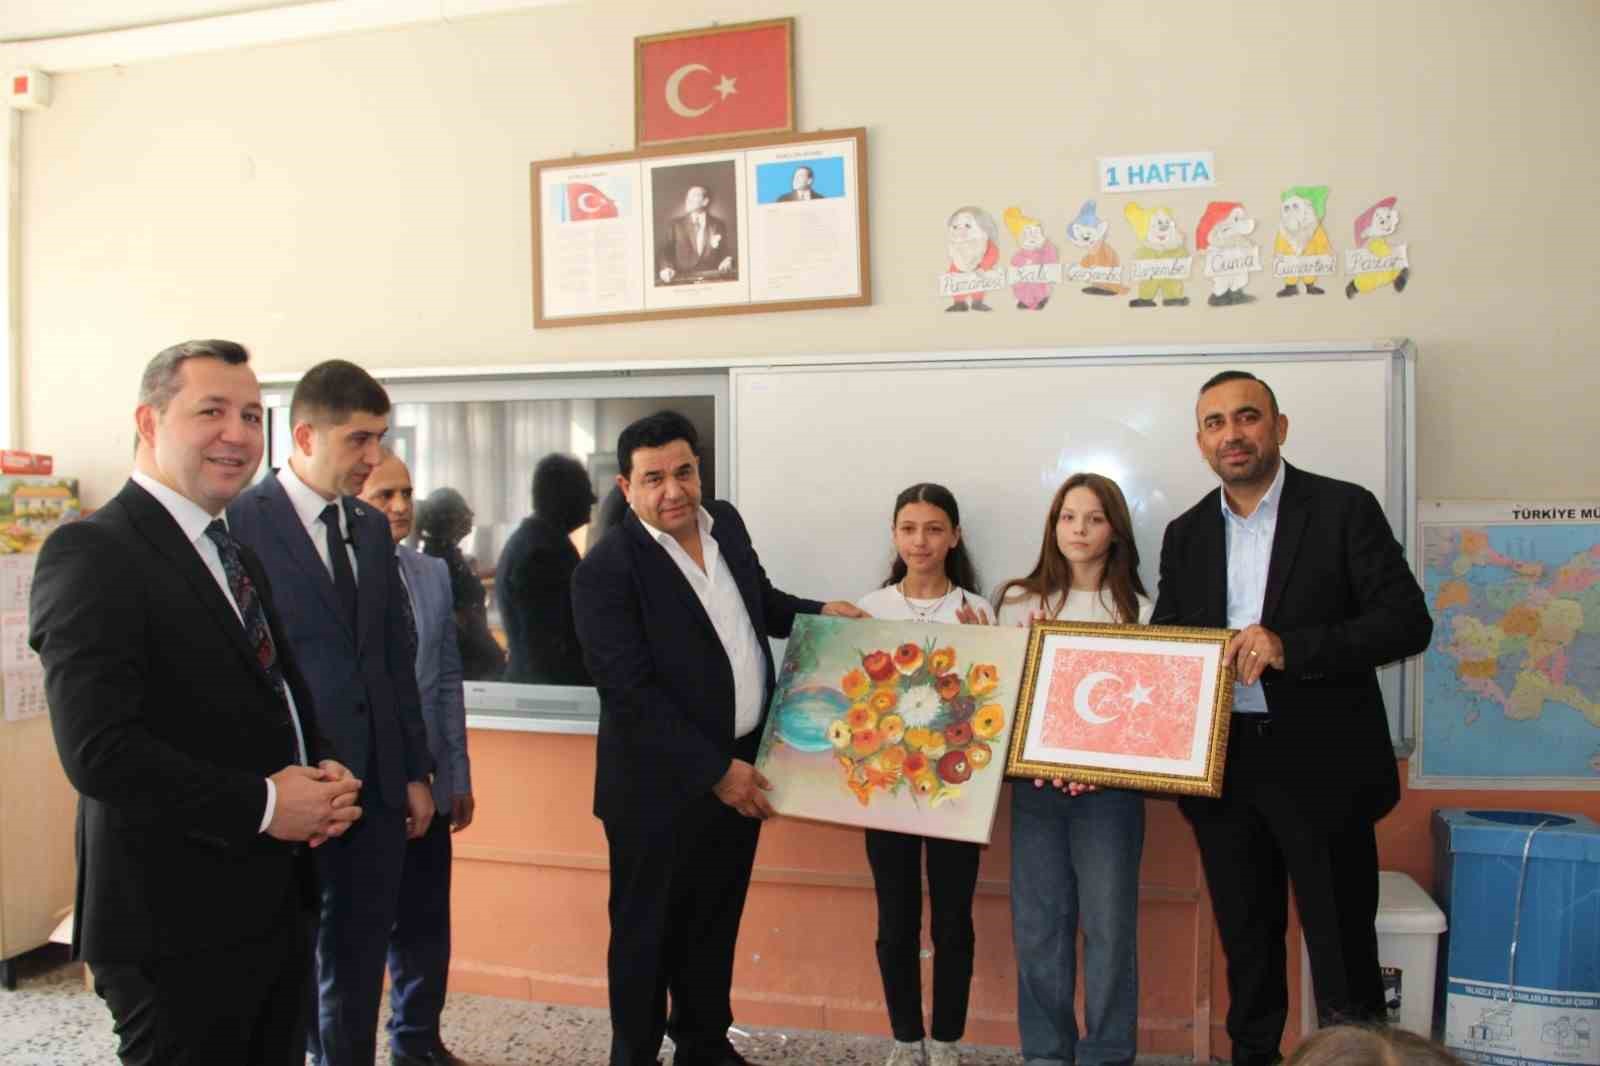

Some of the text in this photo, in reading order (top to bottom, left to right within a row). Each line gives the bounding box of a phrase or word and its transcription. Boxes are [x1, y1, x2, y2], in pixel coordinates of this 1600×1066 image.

[1106, 160, 1210, 186] 1 HAFTA
[1511, 507, 1577, 520] TÜRKİYE
